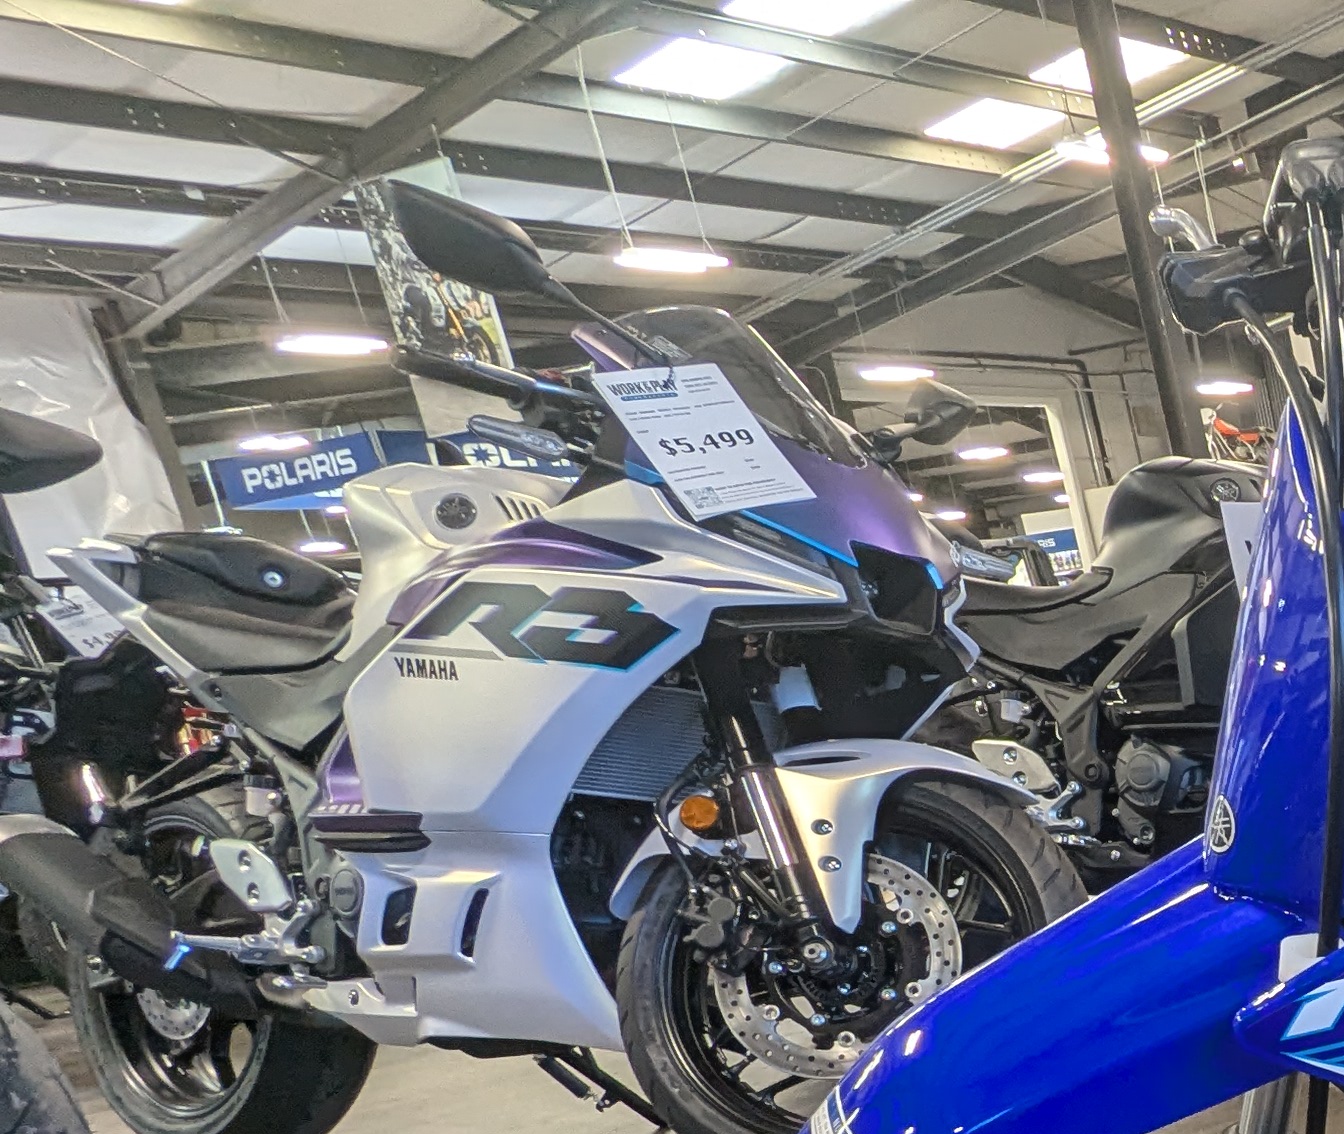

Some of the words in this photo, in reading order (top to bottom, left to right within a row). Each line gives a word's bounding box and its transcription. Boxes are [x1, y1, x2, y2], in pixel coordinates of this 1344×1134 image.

[658, 428, 755, 457] $5,499
[241, 448, 358, 494] POLARIS
[401, 582, 681, 673] R3
[394, 657, 460, 681] YAMAHA
